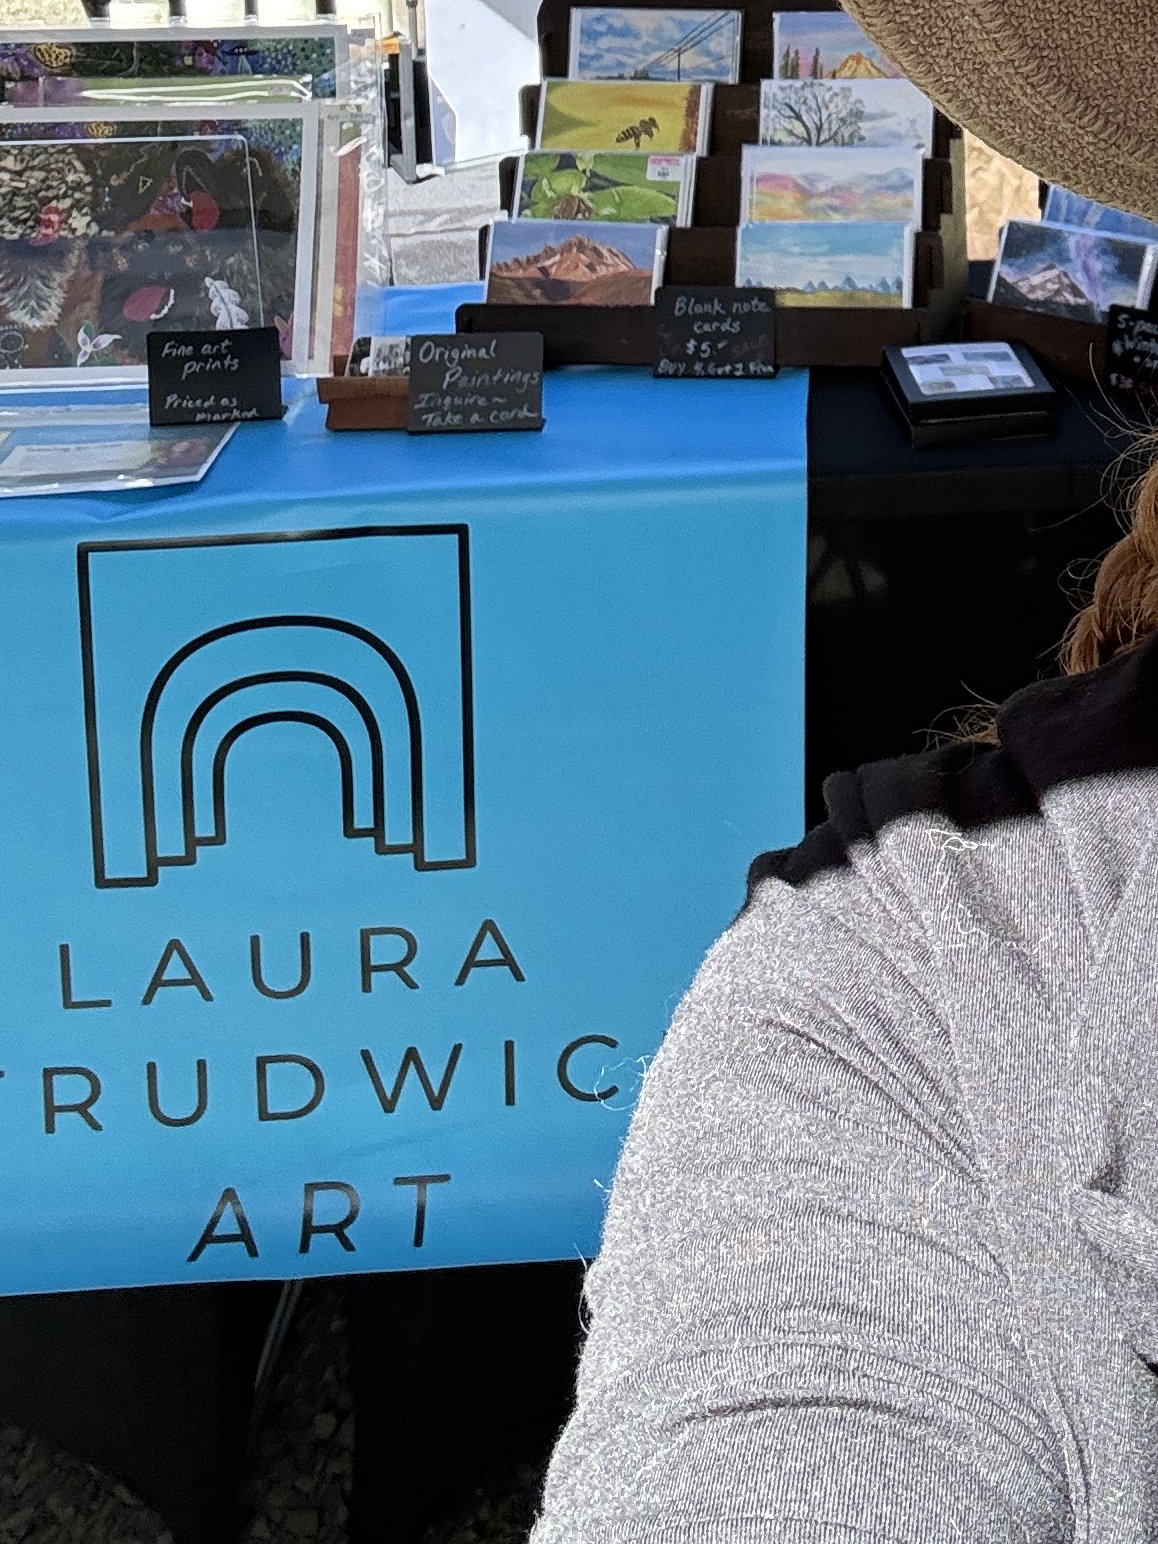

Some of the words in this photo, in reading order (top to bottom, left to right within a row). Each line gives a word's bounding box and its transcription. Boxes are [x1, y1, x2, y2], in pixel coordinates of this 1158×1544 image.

[674, 295, 726, 317] Blank
[732, 296, 772, 314] note
[692, 317, 741, 335] cards
[161, 340, 194, 358] Fine
[201, 338, 233, 355] art
[419, 339, 497, 368] Original
[181, 354, 240, 380] prints
[442, 365, 540, 393] Paintings
[164, 393, 215, 410] Priced
[220, 397, 238, 408] as
[421, 411, 463, 427] Take
[469, 412, 484, 424] a
[489, 403, 538, 424] card
[59, 918, 526, 1010] LAURA
[0, 1034, 620, 1135] RUDWIC
[185, 1172, 453, 1264] ART
